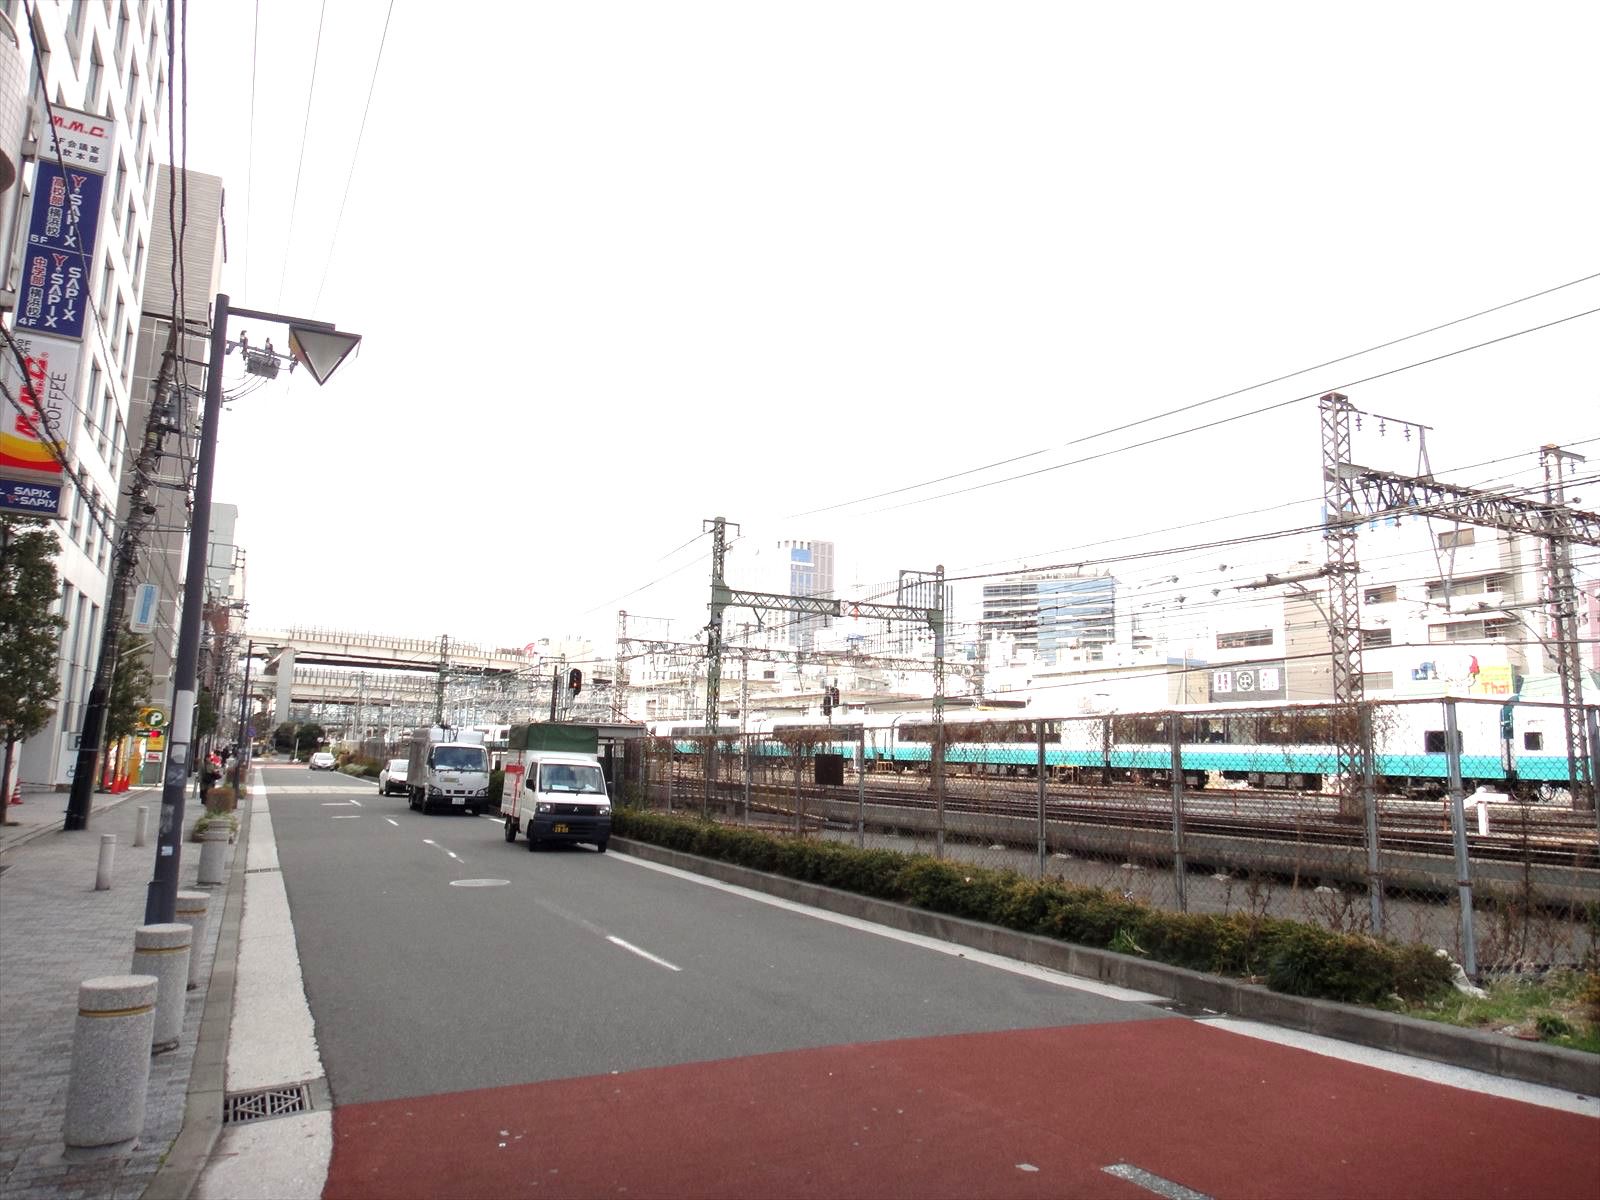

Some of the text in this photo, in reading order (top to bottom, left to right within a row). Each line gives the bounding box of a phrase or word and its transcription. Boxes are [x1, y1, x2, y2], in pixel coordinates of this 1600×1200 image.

[62, 267, 82, 321] SAPIX
[18, 317, 37, 326] 4F
[47, 372, 67, 430] COFFEE
[14, 486, 51, 498] SAPIX
[150, 712, 163, 725] P
